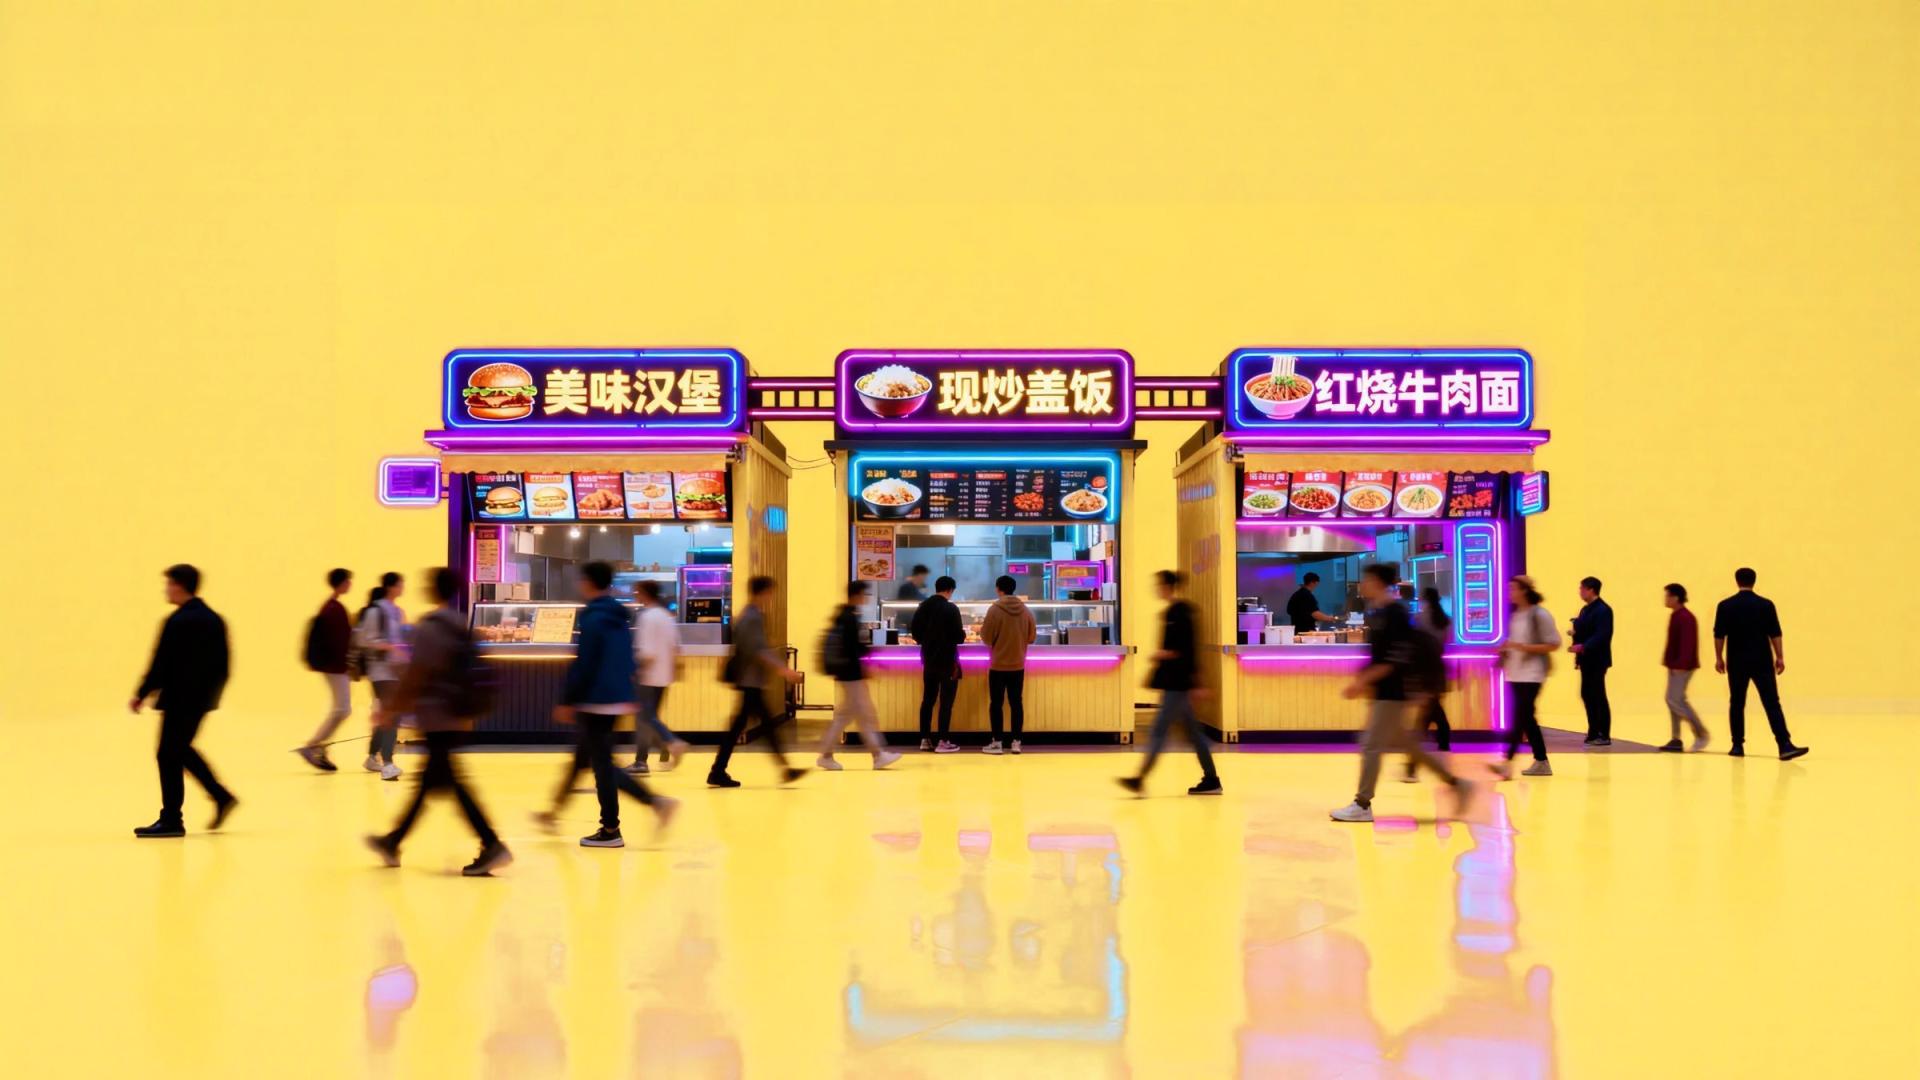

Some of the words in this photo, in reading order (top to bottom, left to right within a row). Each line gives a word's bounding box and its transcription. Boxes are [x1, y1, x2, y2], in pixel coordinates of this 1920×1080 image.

[543, 368, 722, 415] 美味汉堡
[937, 368, 1114, 415] 现炒盖饭
[1314, 368, 1520, 415] 红烧牛肉面
